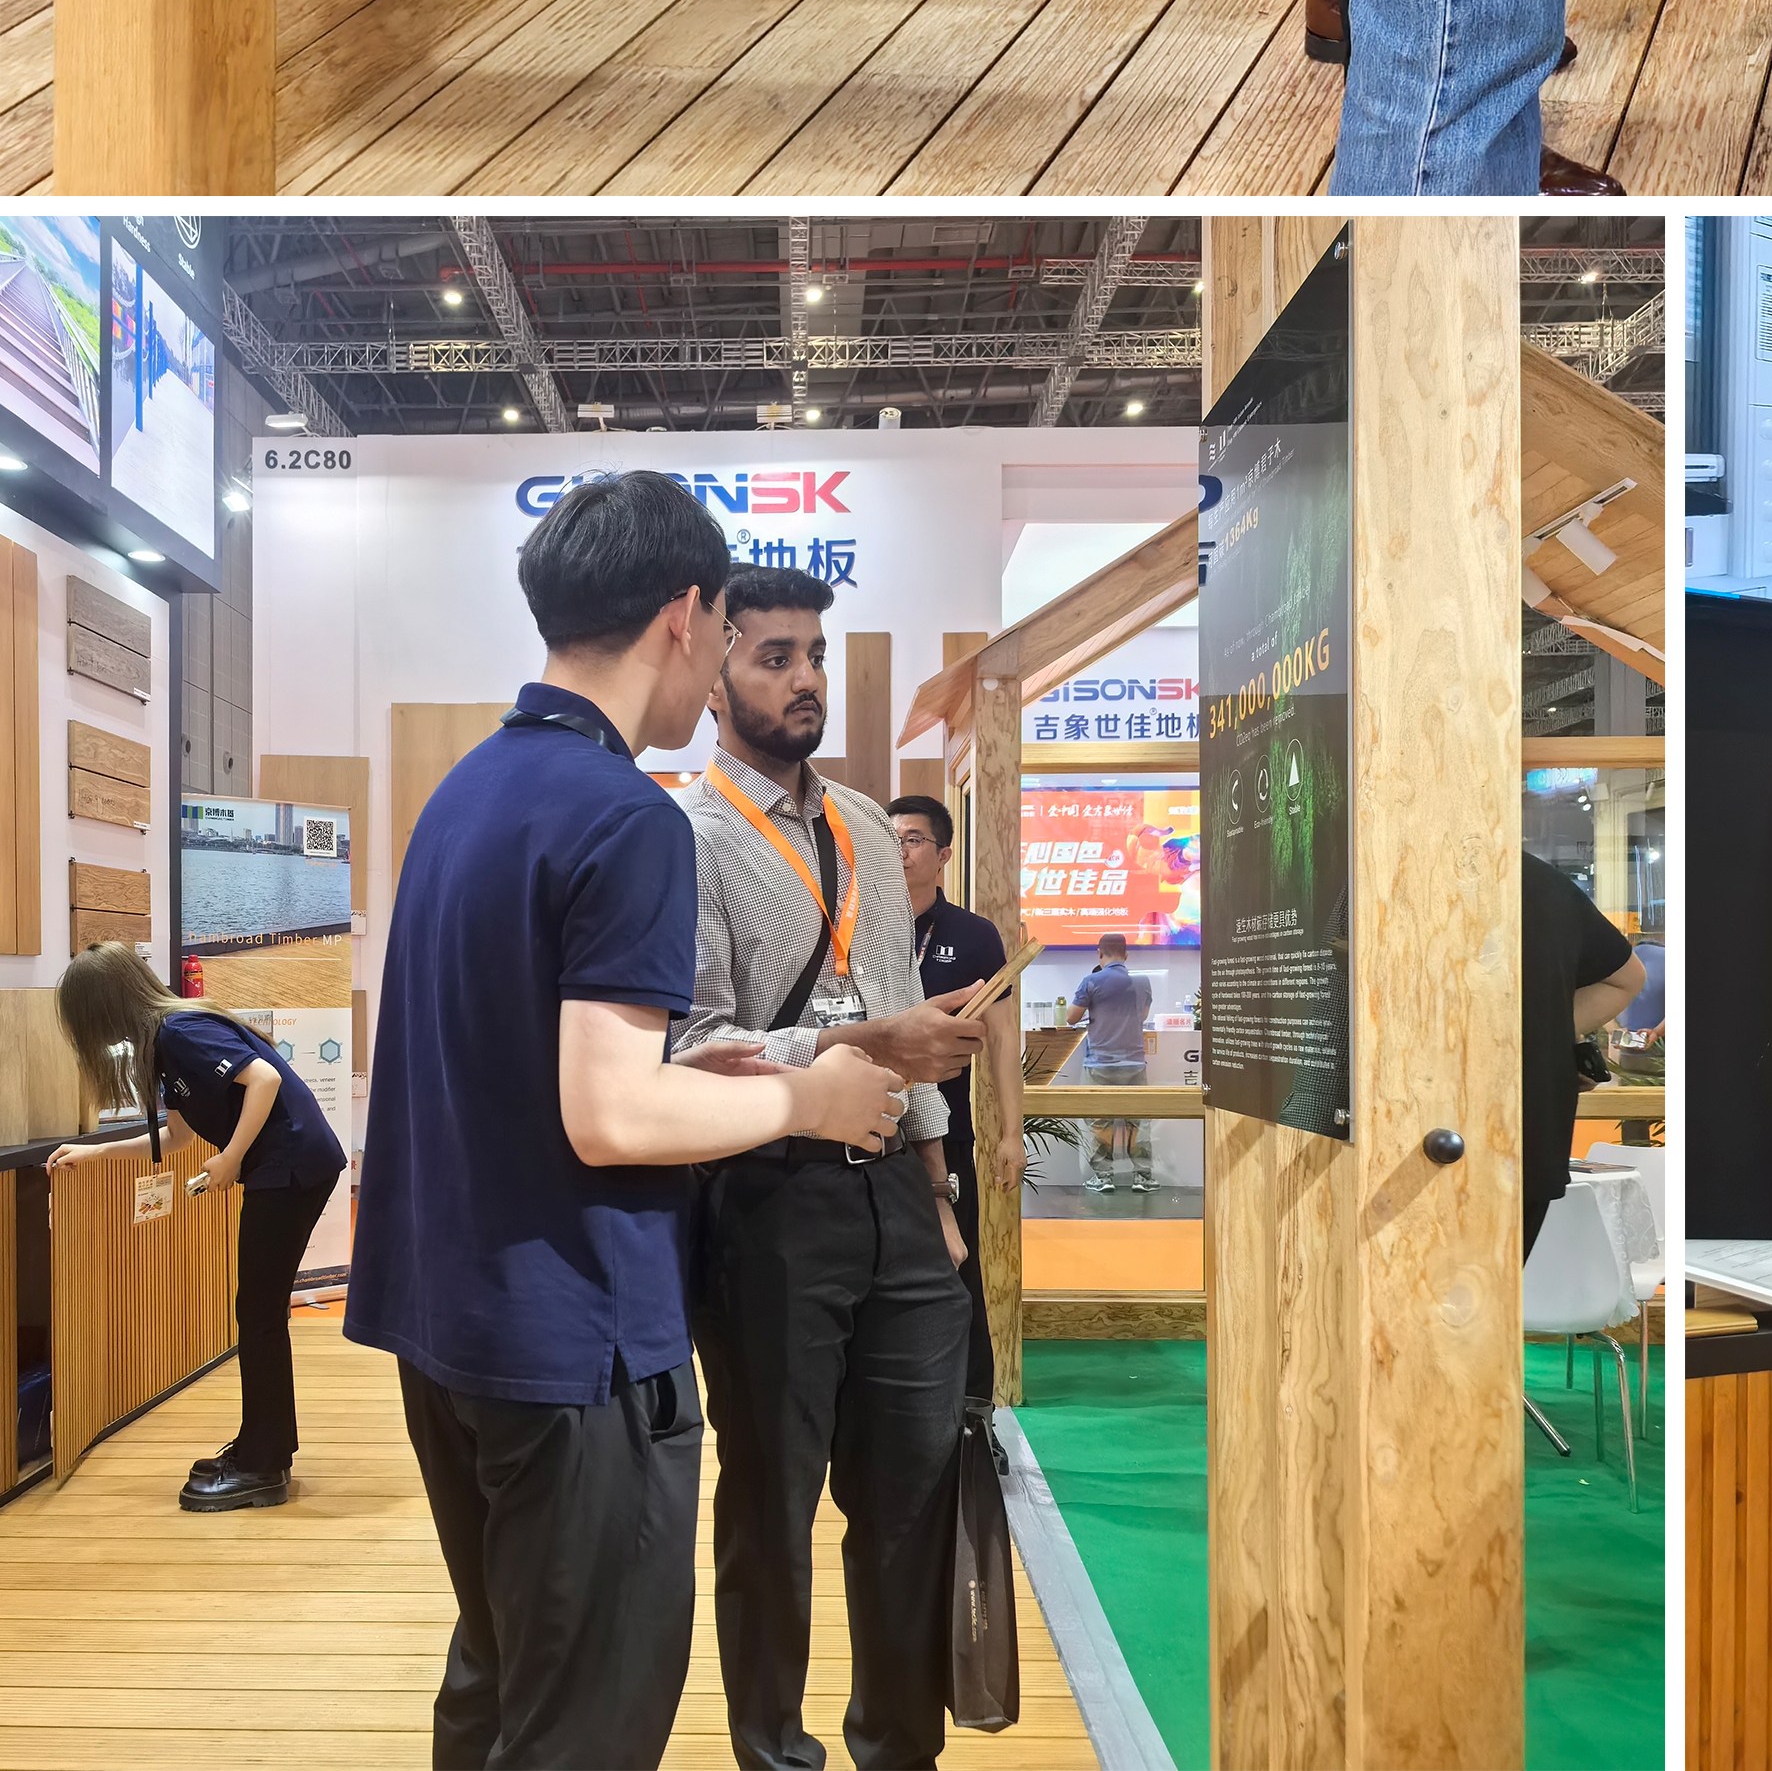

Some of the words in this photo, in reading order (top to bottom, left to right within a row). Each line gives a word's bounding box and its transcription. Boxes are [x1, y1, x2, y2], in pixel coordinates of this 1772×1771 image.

[178, 252, 196, 281] Stable
[264, 449, 352, 470] 6.2C80
[1256, 641, 1270, 659] total
[1271, 630, 1279, 648] of
[1209, 626, 1330, 739] 341,000,000KG
[269, 932, 318, 946] Timber
[321, 934, 343, 946] MP
